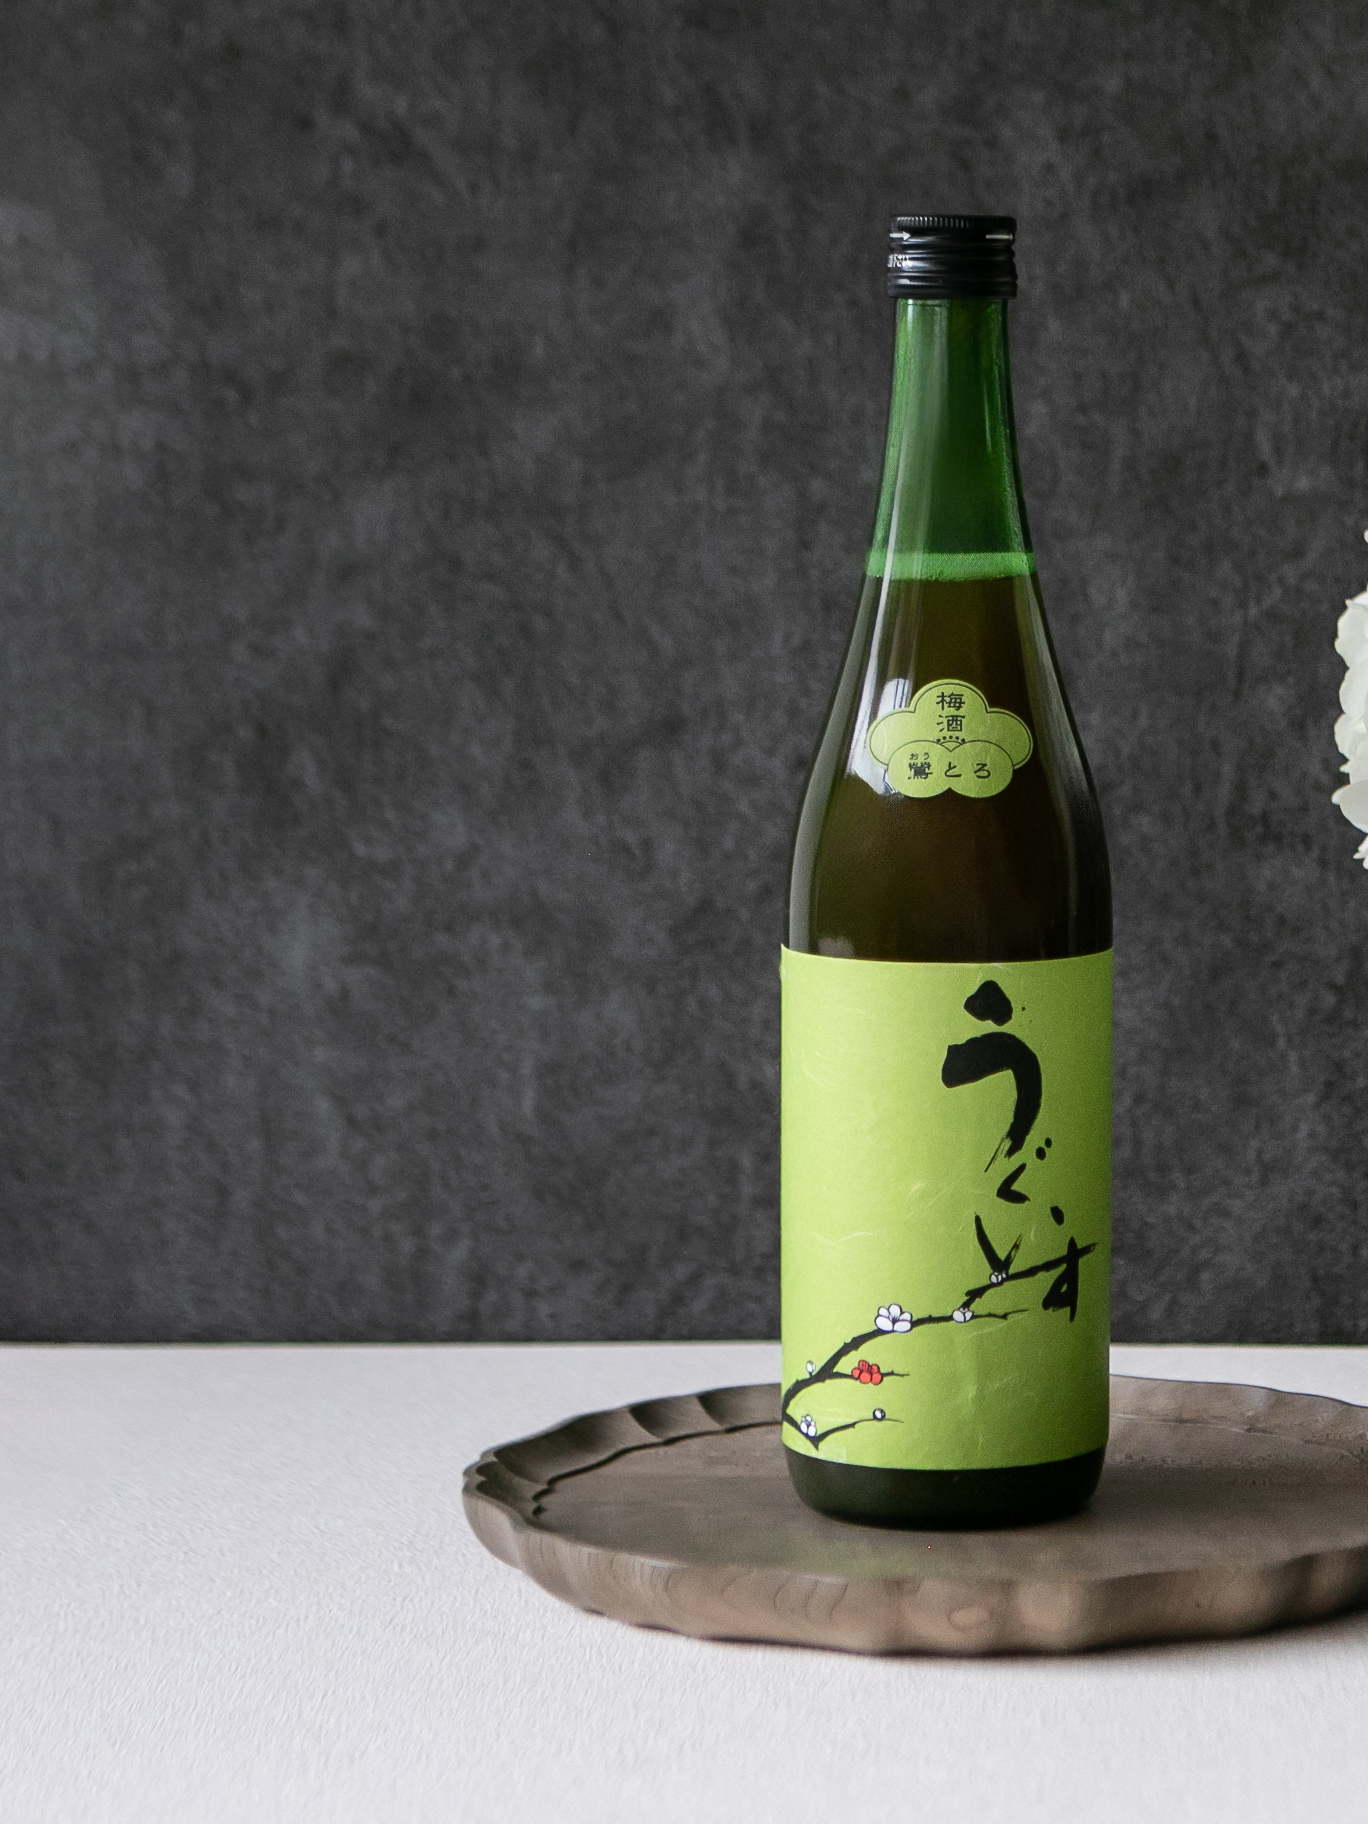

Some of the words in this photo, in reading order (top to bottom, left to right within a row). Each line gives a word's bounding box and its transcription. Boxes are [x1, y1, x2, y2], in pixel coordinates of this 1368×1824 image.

[936, 691, 966, 732] 梅酒
[909, 752, 930, 761] おう
[941, 980, 1098, 1322] うぐいす
